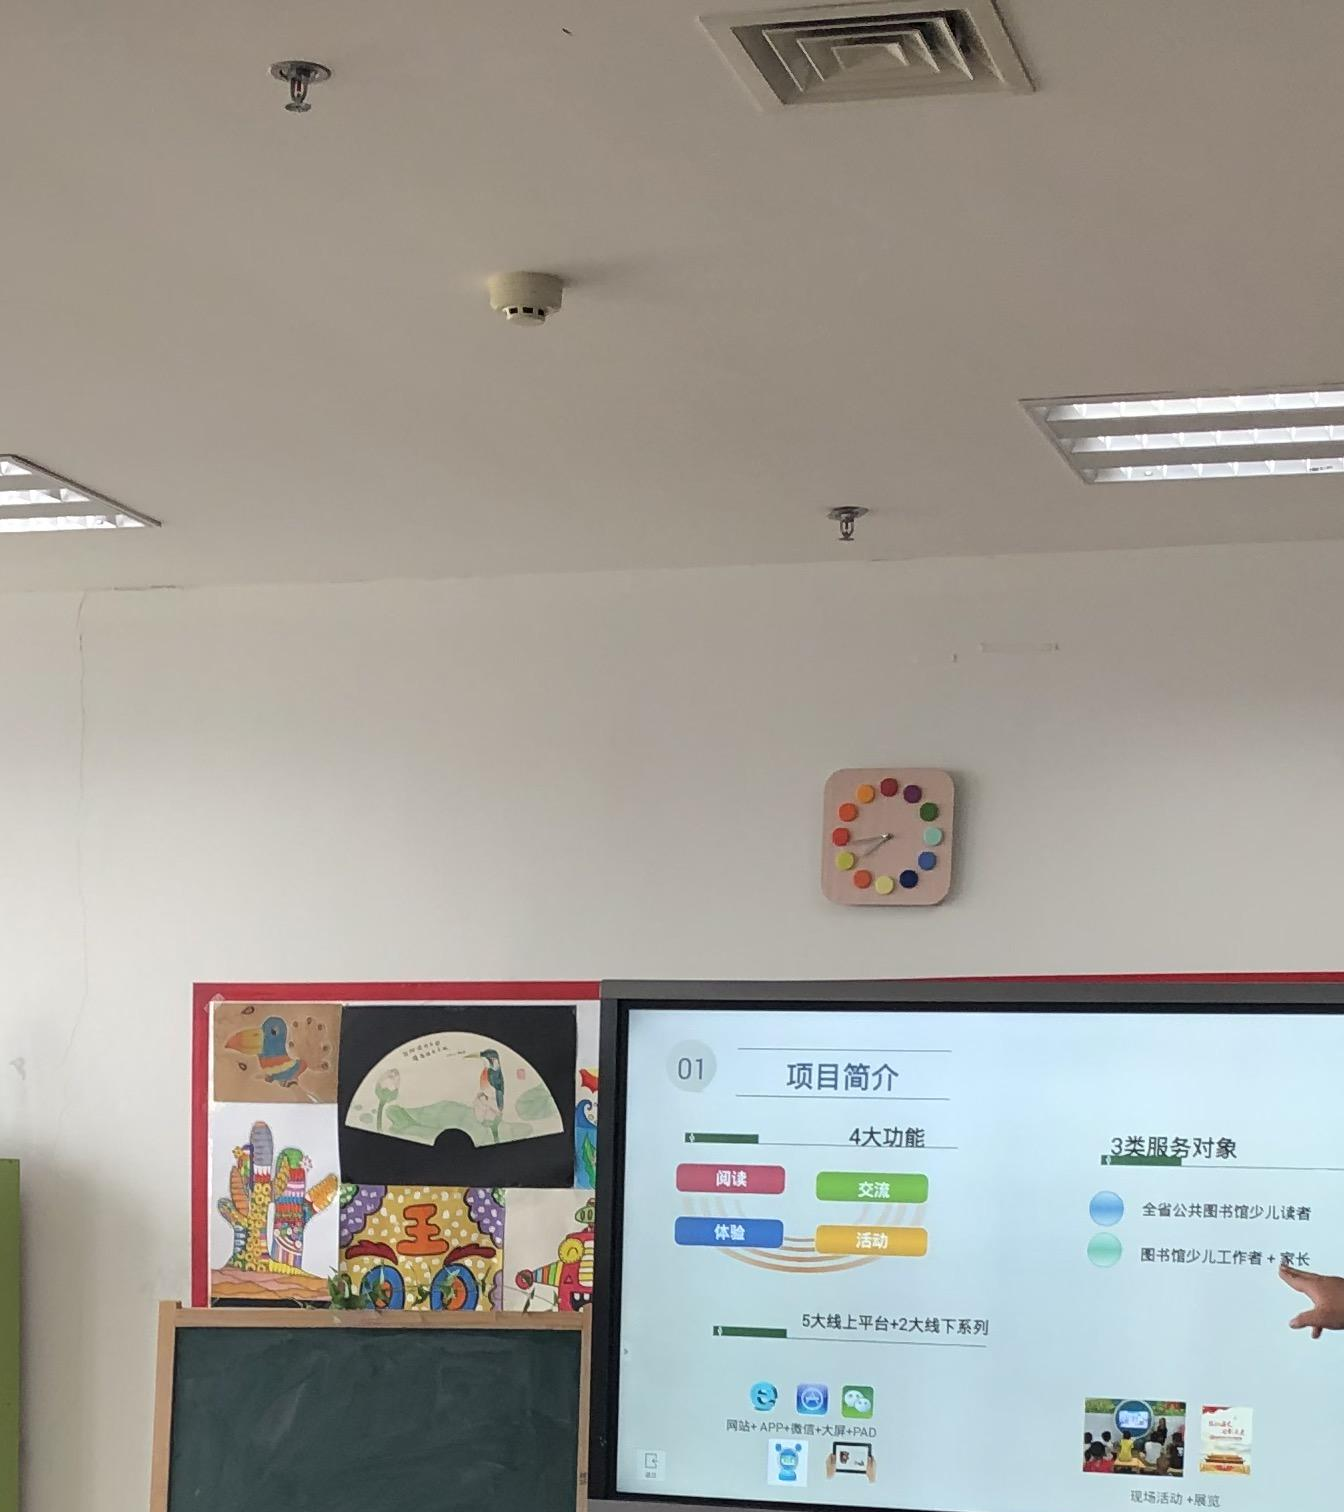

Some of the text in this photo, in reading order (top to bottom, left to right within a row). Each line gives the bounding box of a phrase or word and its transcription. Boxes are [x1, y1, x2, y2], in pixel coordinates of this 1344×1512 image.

[677, 1057, 704, 1080] 01
[786, 1062, 899, 1092] 项目简介
[849, 1126, 925, 1148] 4大功能
[1111, 1135, 1237, 1159] 3类服务对象
[716, 1170, 748, 1187] 阅读
[858, 1181, 890, 1199] 交流
[1142, 1202, 1312, 1221] 全省公共图书馆少儿读者
[714, 1223, 746, 1241] 体验
[856, 1232, 889, 1250] 活动
[1140, 1247, 1262, 1265] 图书馆少儿工作者
[802, 1313, 990, 1336] 5大线上平台+2大线下系列
